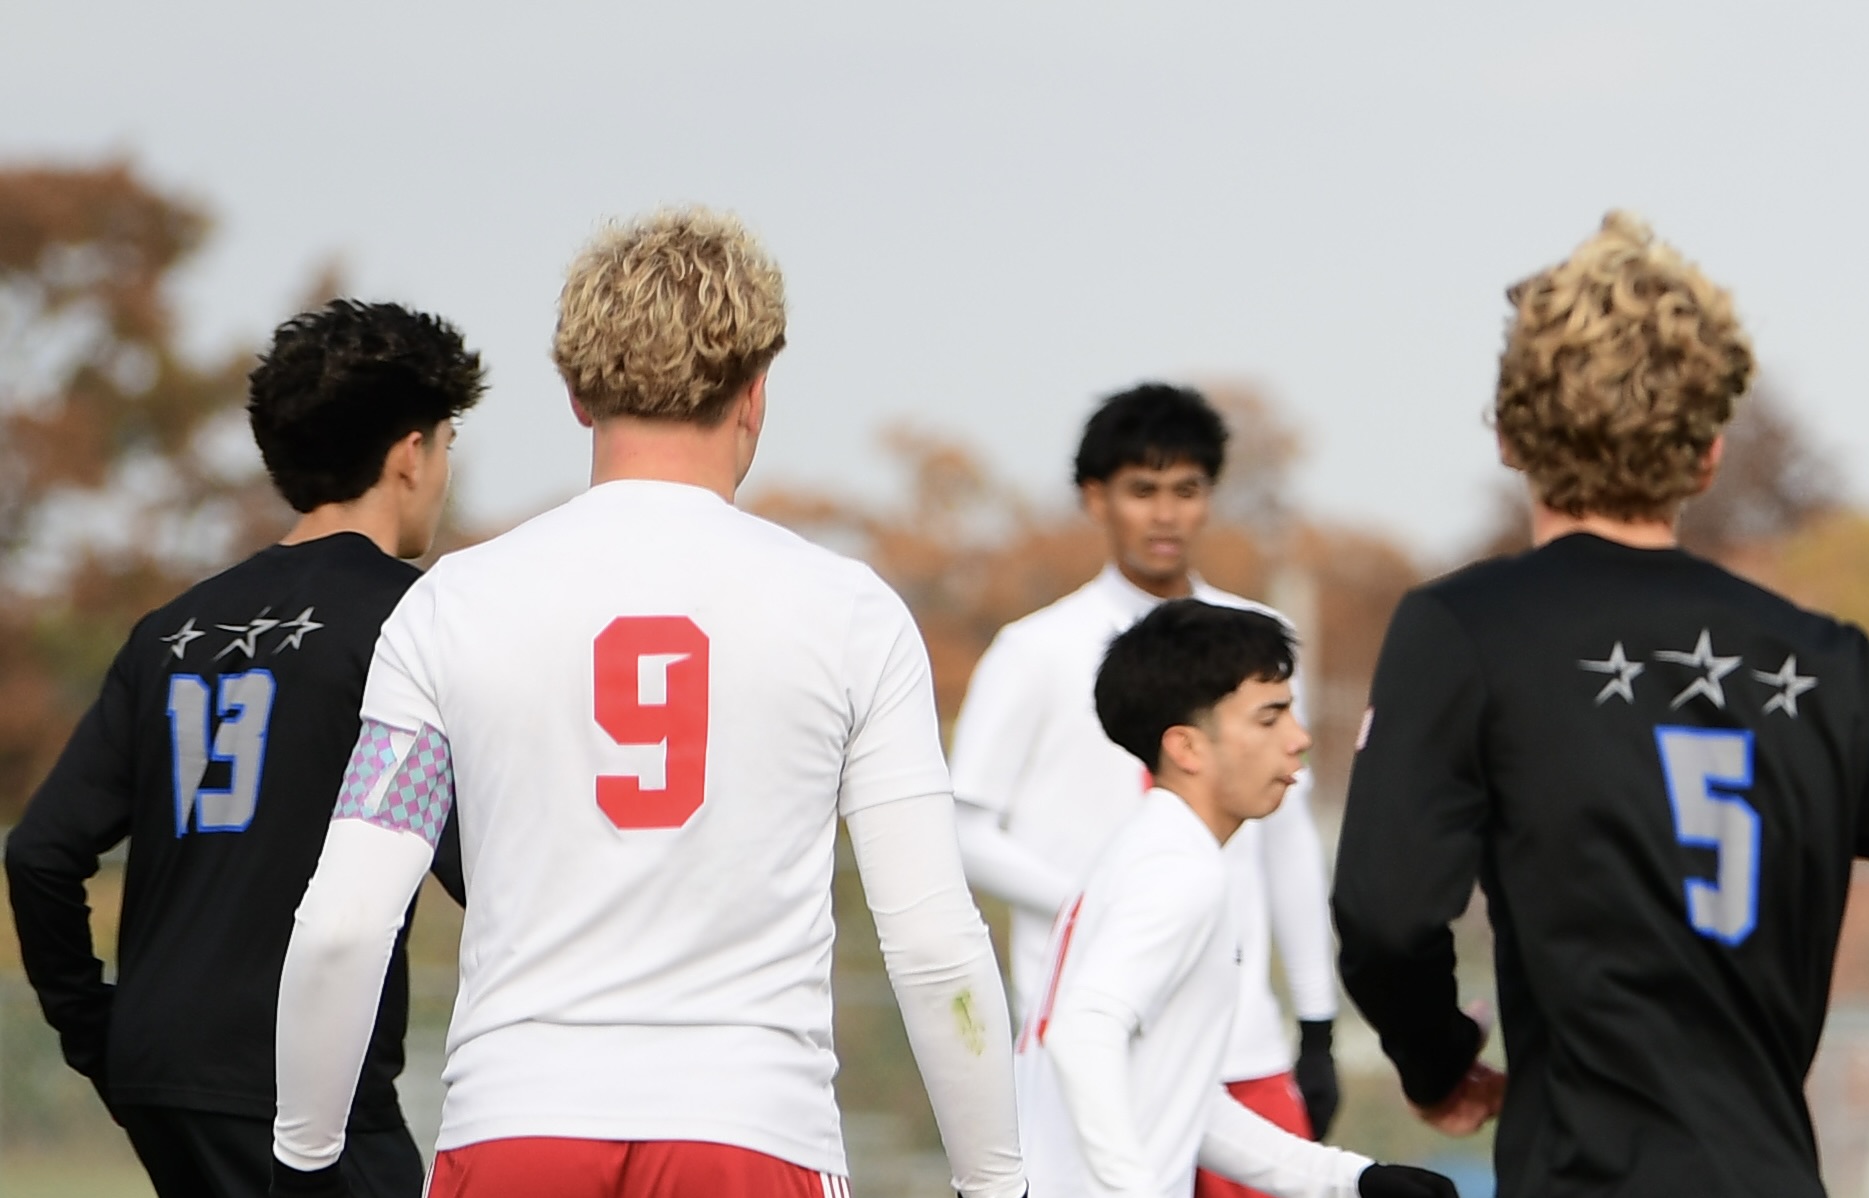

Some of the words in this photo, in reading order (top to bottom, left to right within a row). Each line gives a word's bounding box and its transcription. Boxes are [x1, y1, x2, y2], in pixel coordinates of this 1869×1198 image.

[166, 668, 278, 838] 13
[593, 615, 710, 830] 9
[1654, 724, 1762, 947] 5
